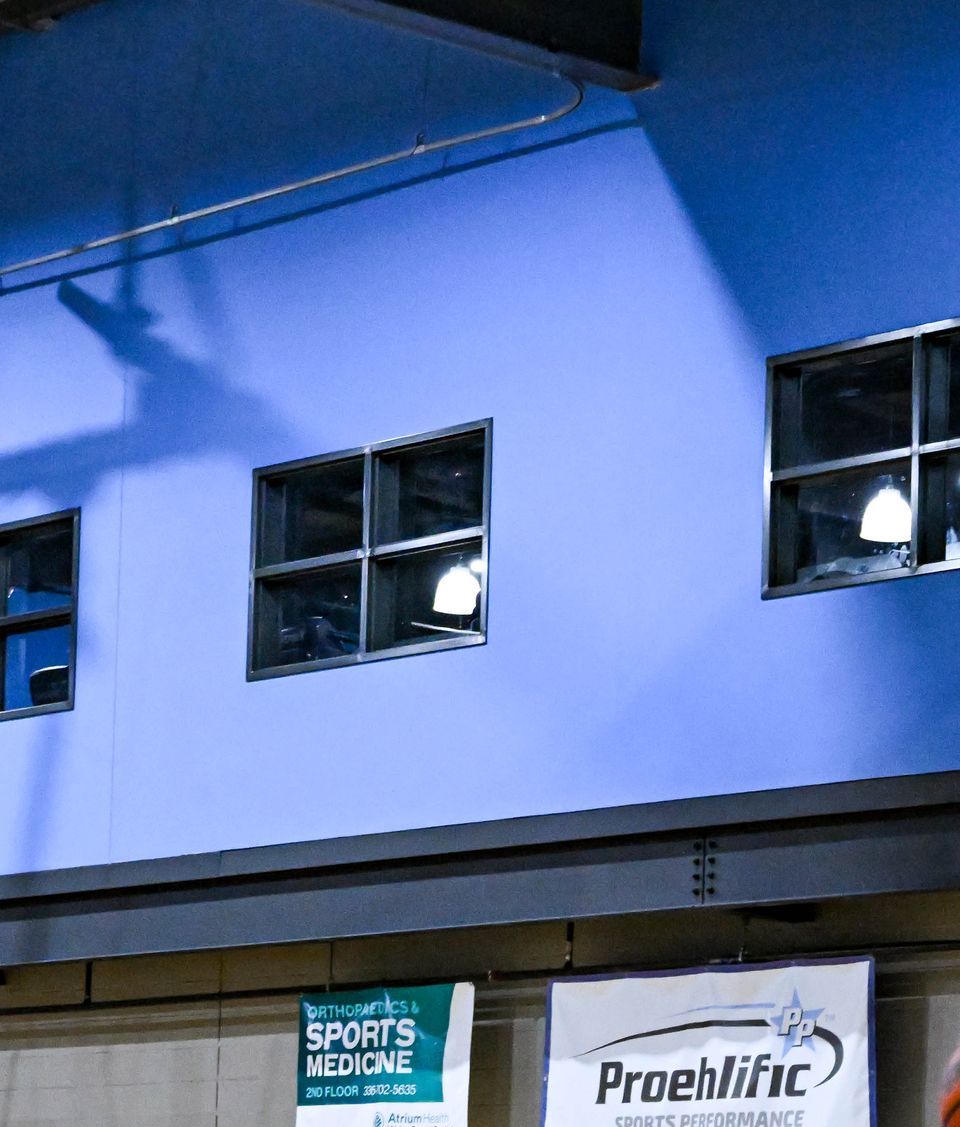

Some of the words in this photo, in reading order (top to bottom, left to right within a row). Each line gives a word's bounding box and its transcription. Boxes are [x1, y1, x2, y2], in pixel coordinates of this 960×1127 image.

[307, 1001, 408, 1018] ORTHOPAEDICS
[411, 1001, 420, 1014] &
[306, 1018, 416, 1051] SPORTS
[306, 1051, 413, 1077] MEDICINE
[595, 1053, 811, 1105] Proehlific
[306, 1087, 323, 1098] 2ND
[325, 1085, 359, 1097] FLOOR
[388, 1113, 422, 1123] Atrium
